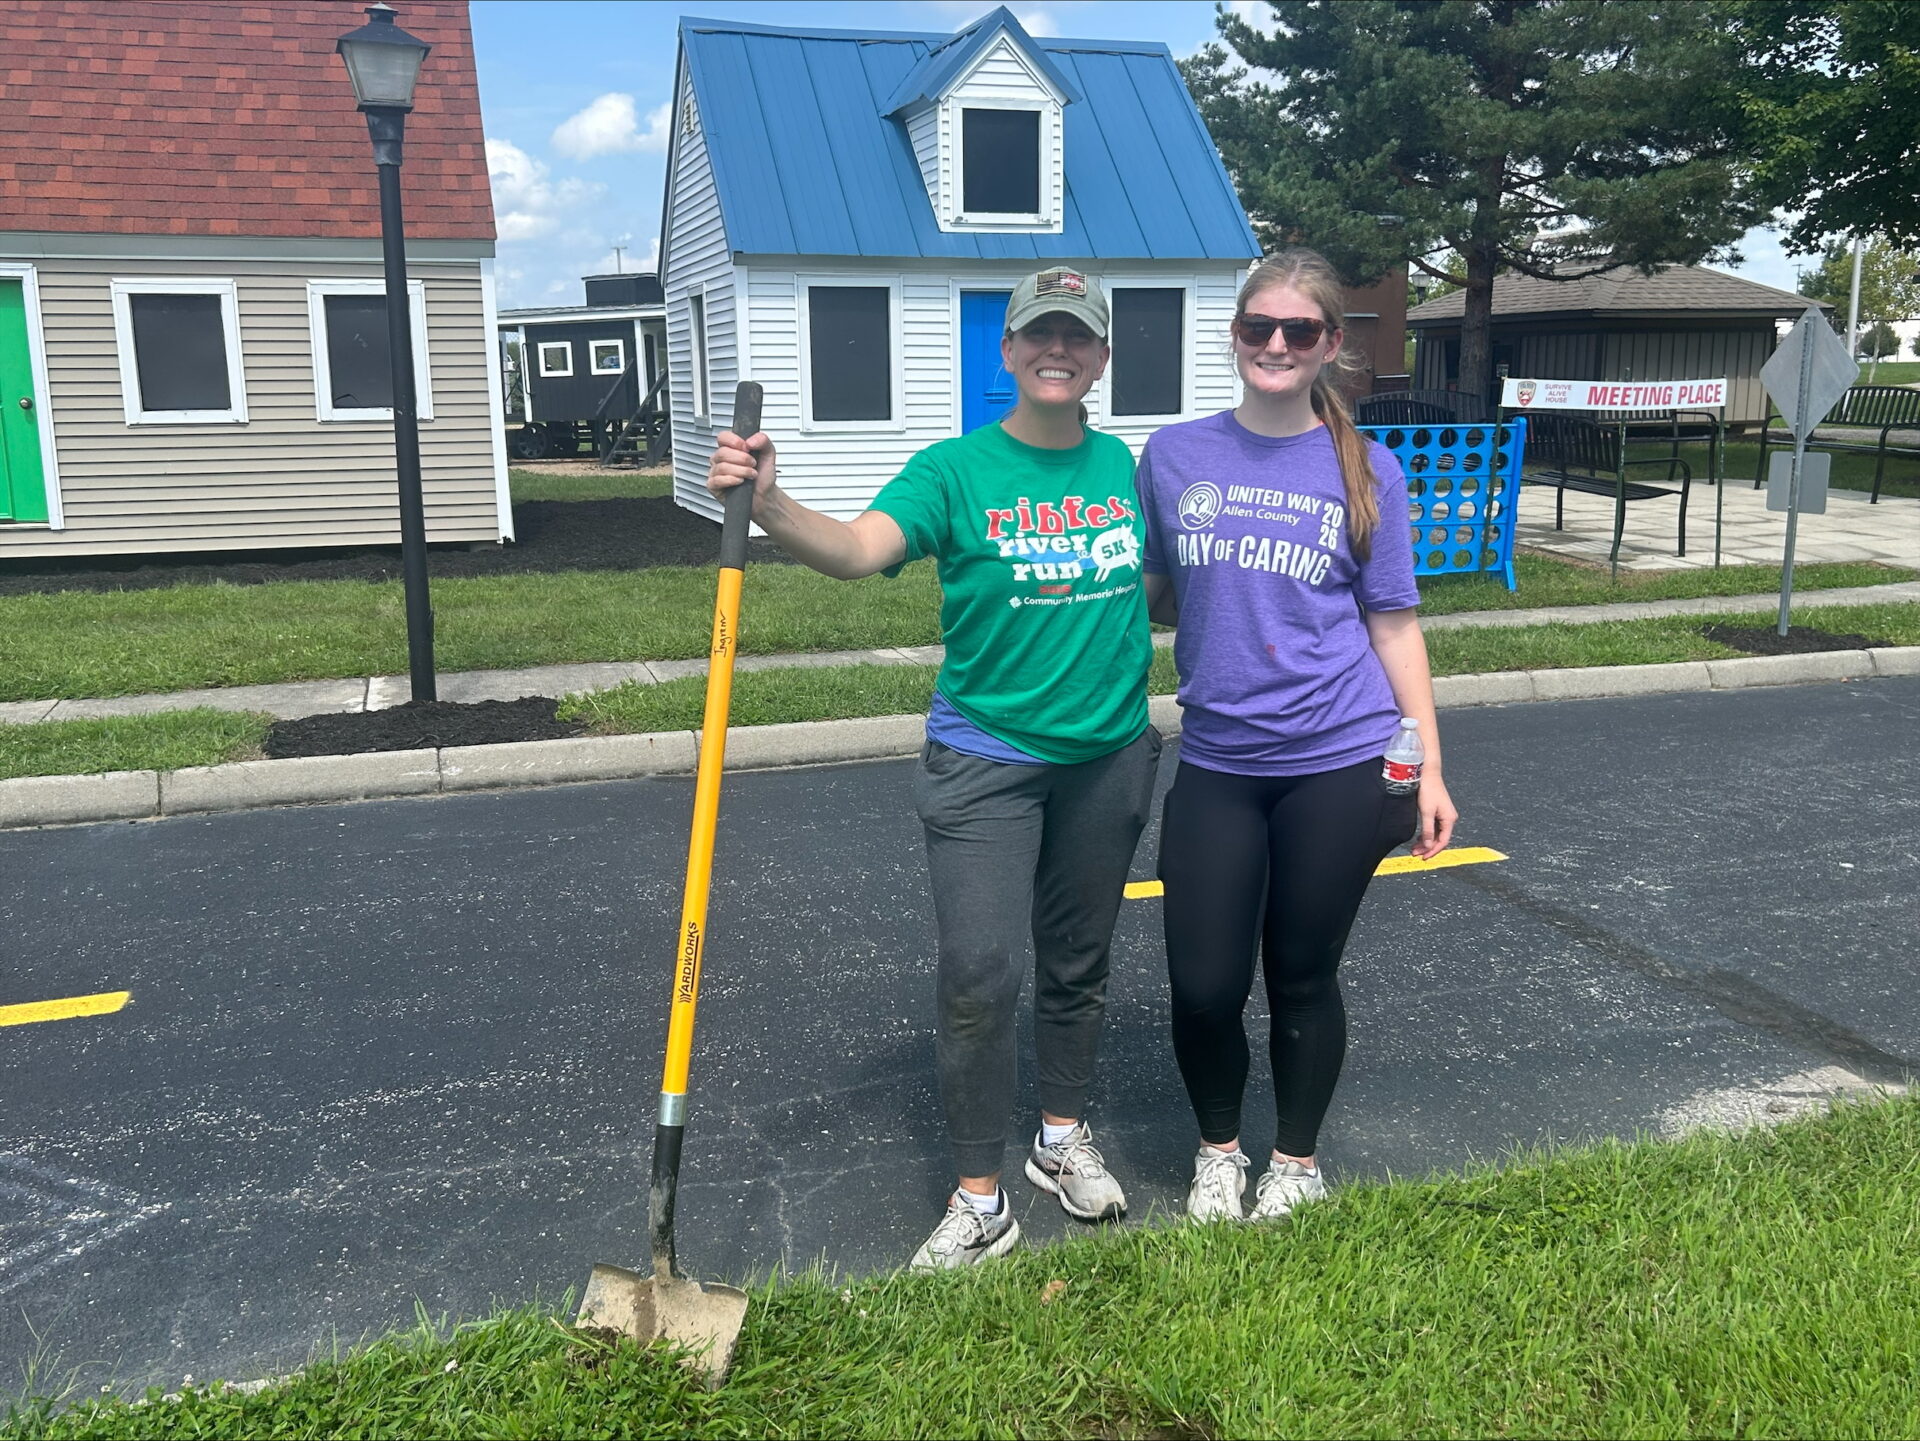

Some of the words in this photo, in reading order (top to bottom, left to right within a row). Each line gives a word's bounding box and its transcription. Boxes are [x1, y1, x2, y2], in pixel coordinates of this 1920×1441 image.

[1587, 385, 1673, 406] MEETING
[1677, 383, 1722, 405] PLACE
[1227, 484, 1284, 507] UNITED
[1287, 492, 1322, 515] WAY
[1221, 505, 1253, 518] Allen
[1256, 508, 1300, 527] County
[1321, 502, 1344, 529] 20
[998, 532, 1088, 557] river
[1101, 539, 1127, 560] 5K
[1318, 524, 1338, 551] 26
[1012, 560, 1083, 581] run
[1177, 533, 1215, 567] DAY
[1214, 538, 1236, 562] OF
[1238, 535, 1332, 586] CARING
[678, 921, 699, 1003] YARDWORKS
